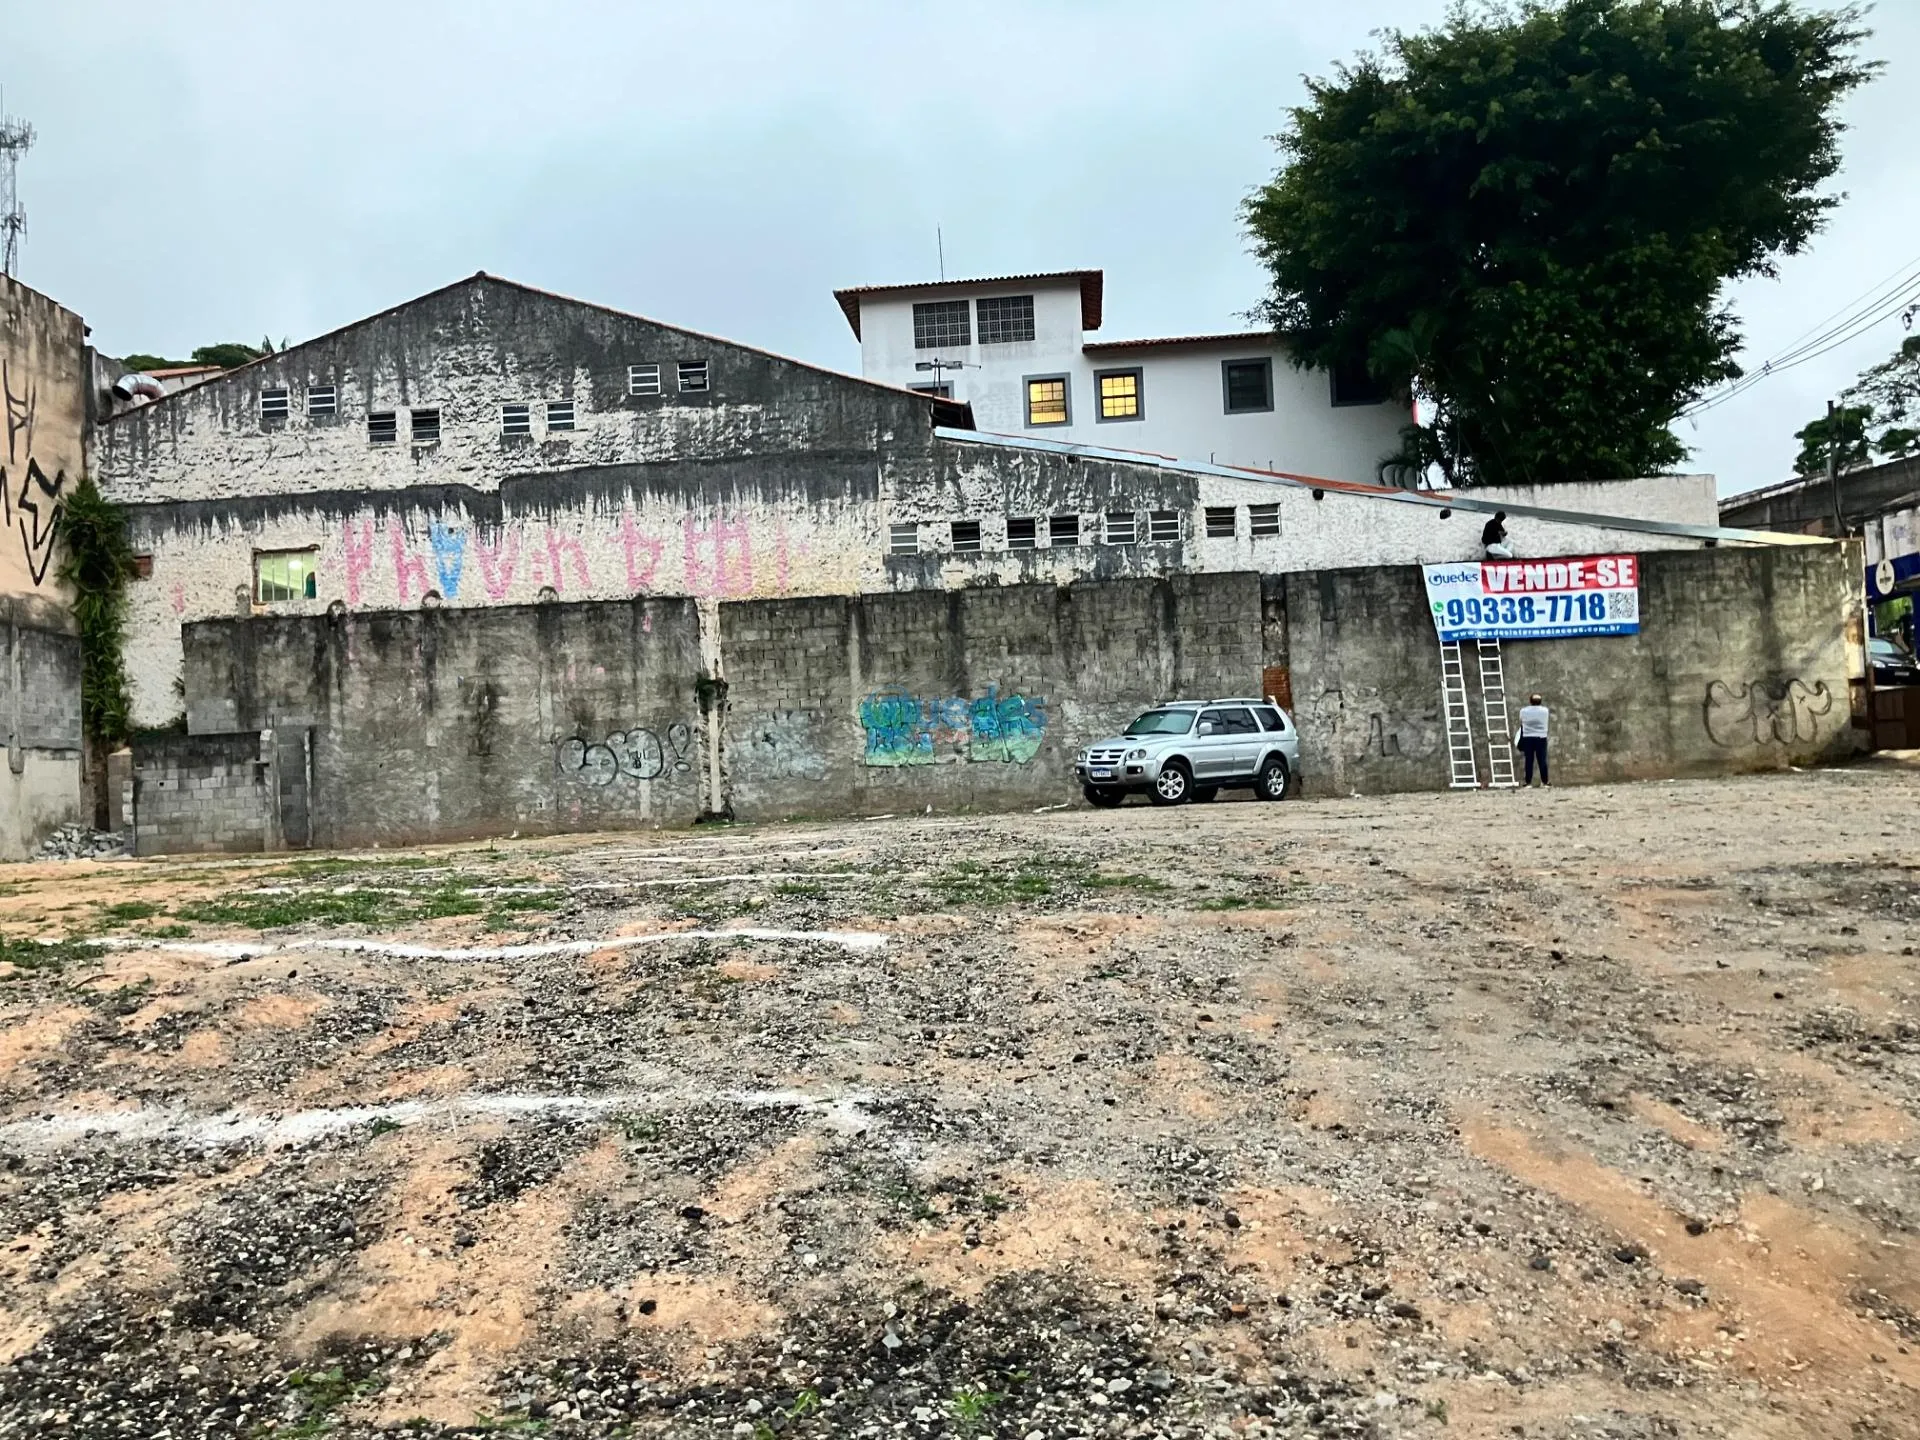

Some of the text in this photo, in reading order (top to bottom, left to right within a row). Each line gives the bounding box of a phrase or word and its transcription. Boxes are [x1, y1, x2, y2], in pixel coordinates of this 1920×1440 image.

[1428, 571, 1478, 586] Guedes
[1484, 558, 1634, 591] VENDE-SE
[1447, 593, 1605, 626] 99338-7718
